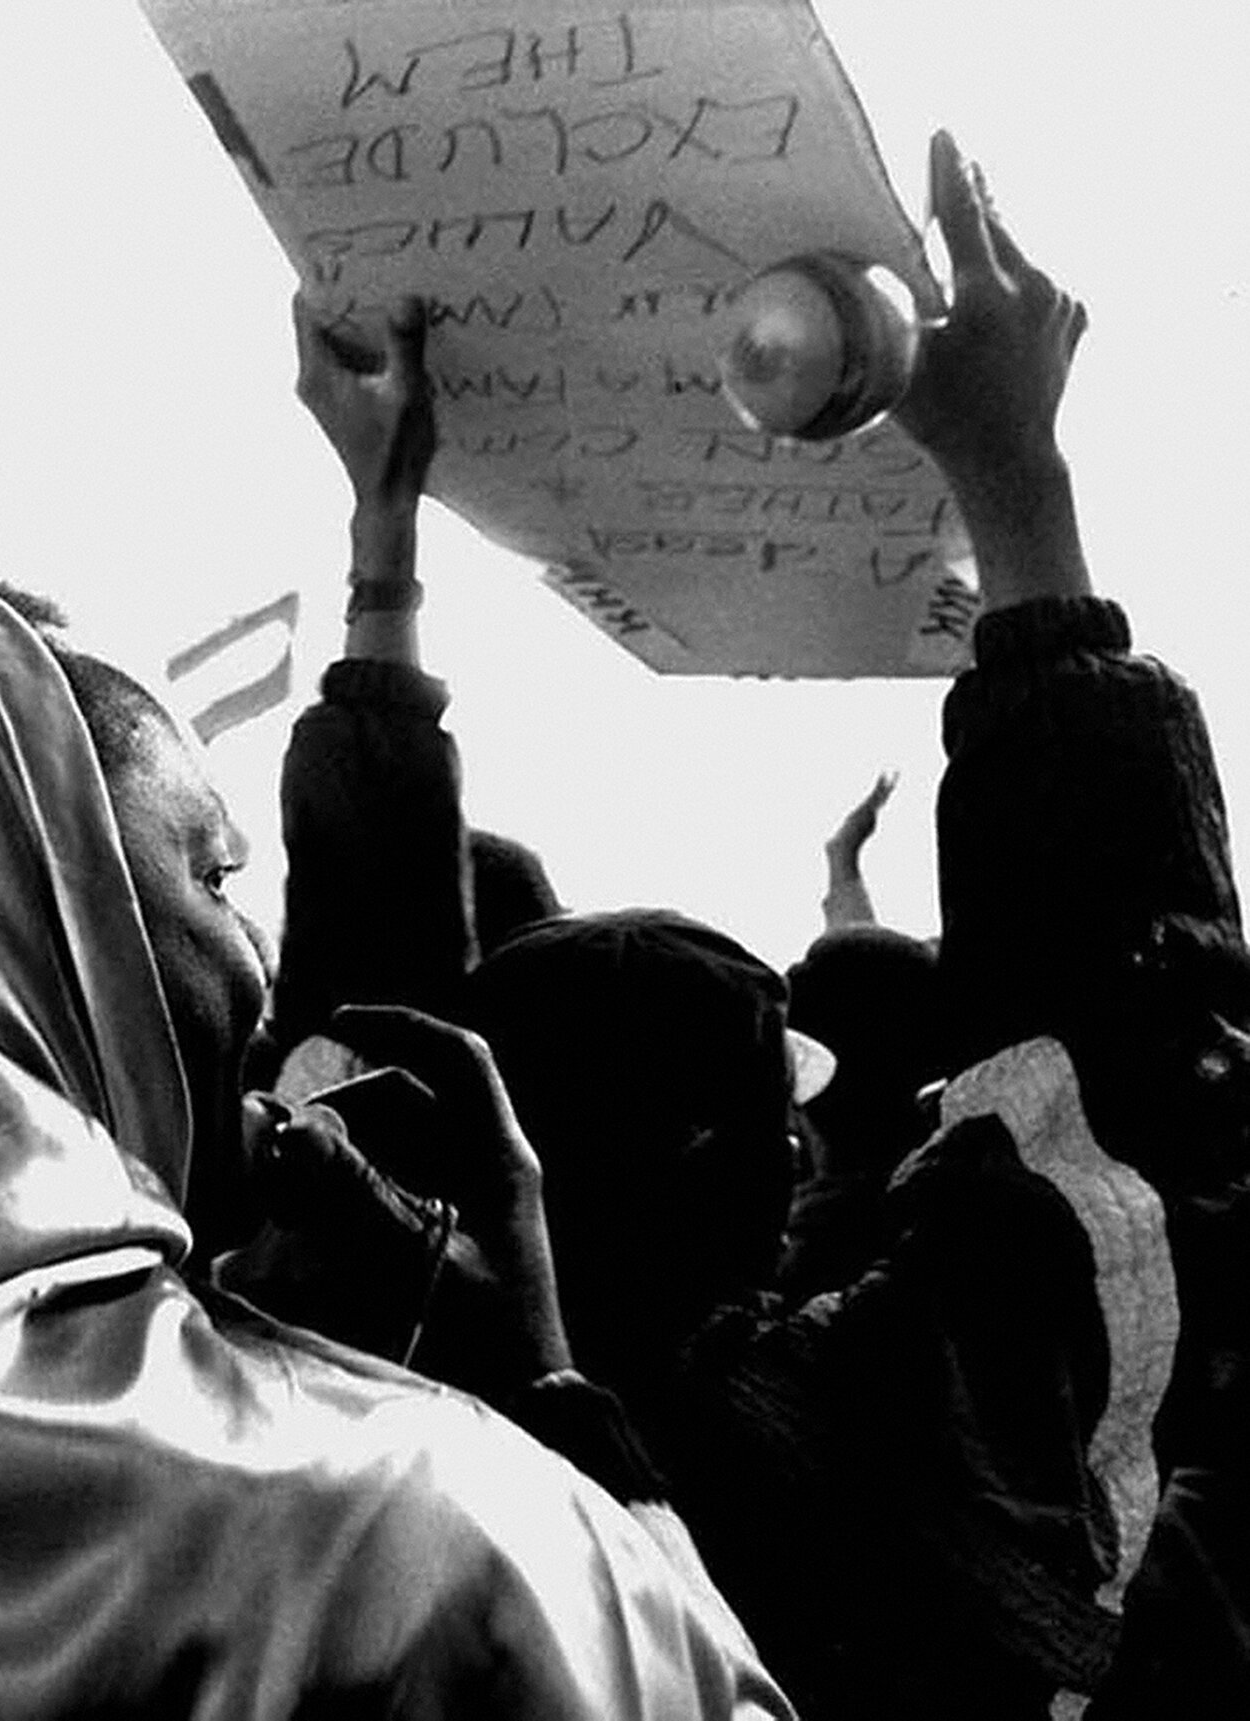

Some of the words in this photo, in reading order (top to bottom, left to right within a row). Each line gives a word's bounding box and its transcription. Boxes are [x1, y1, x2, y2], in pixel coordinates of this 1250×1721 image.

[341, 13, 665, 110] THEM
[282, 96, 801, 190] EXCLUDE
[635, 480, 948, 539] FATHER
[870, 548, 932, 588] A
